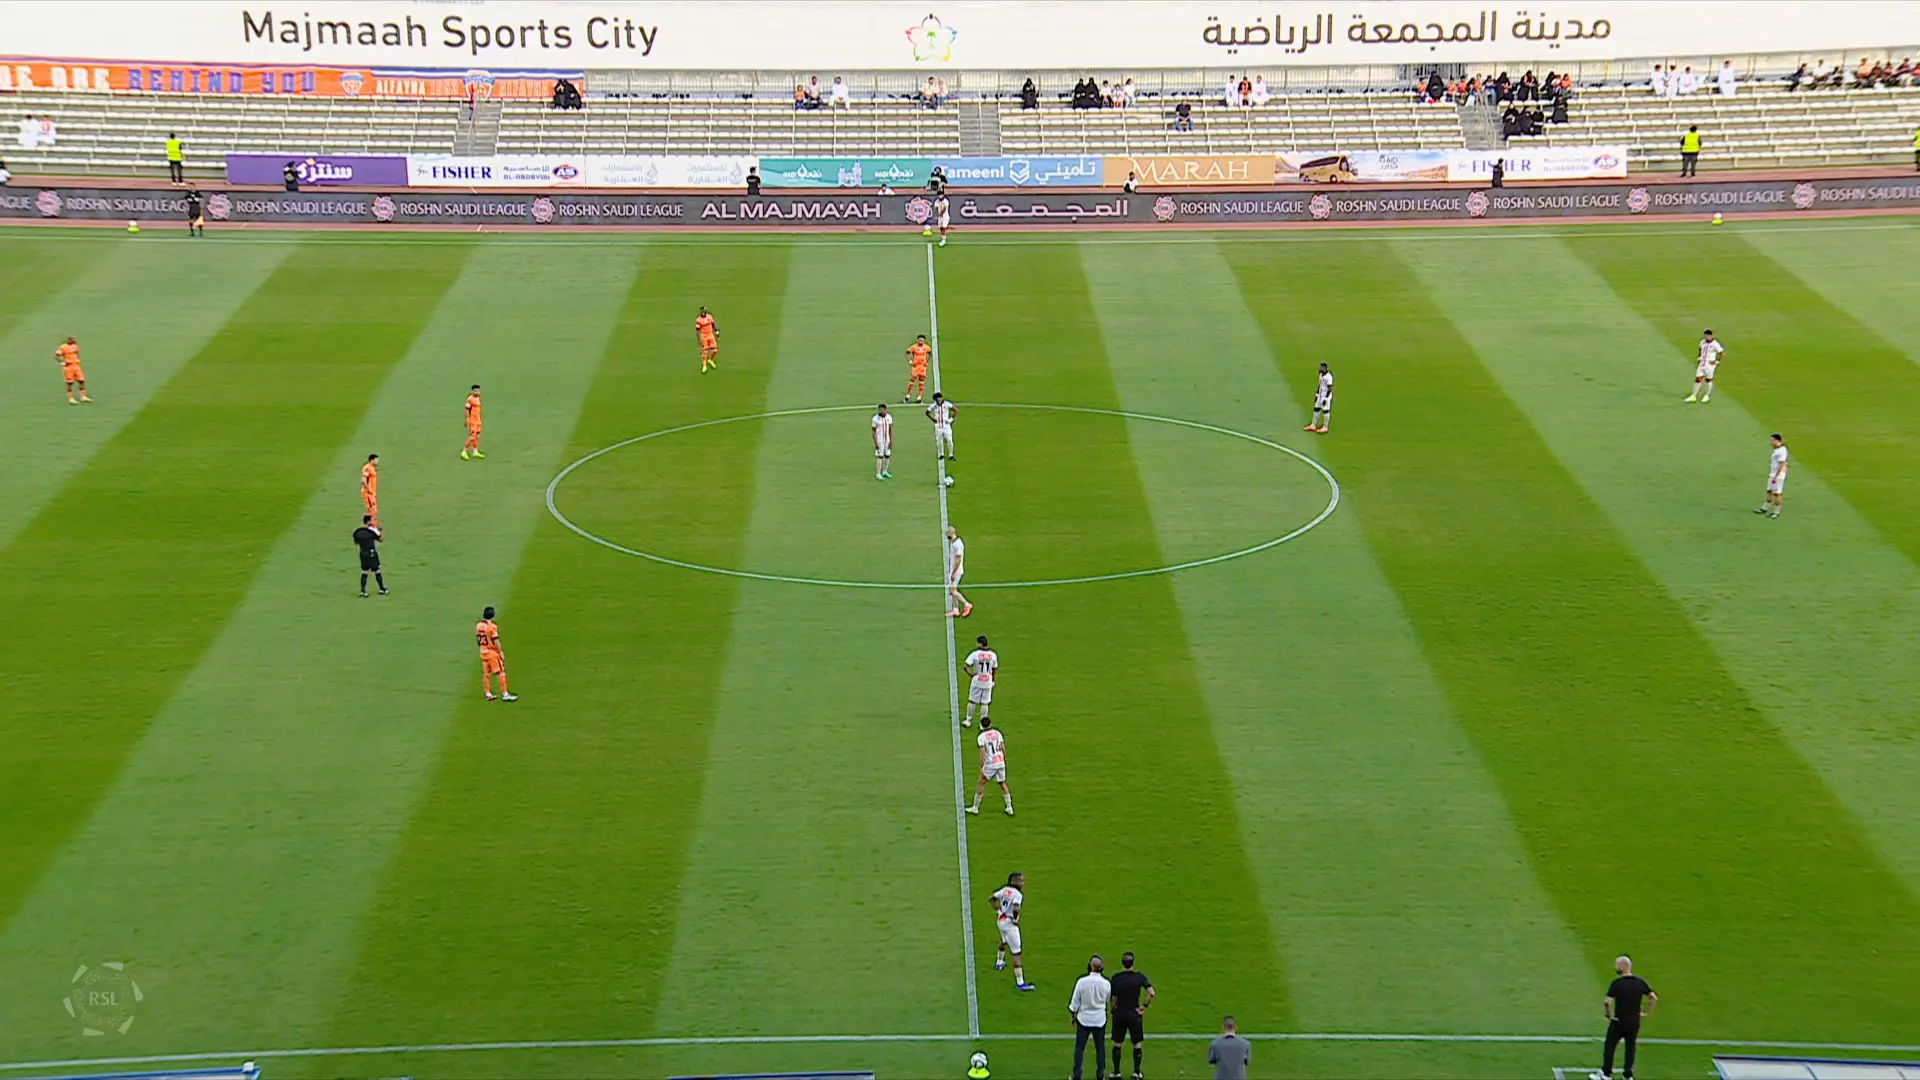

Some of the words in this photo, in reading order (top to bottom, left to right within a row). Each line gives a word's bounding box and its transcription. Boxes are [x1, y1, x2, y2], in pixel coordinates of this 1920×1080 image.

[242, 10, 428, 52] Majmaah
[442, 15, 573, 56] Sports
[586, 16, 658, 57] City
[1203, 13, 1334, 54] الرياضية
[1347, 10, 1498, 51] المجمعة
[1511, 10, 1612, 49] مدينة
[128, 68, 242, 93] BEHIND
[262, 71, 315, 93] YOU
[432, 165, 493, 180] FISHER
[1128, 157, 1249, 184] MARAH
[1655, 192, 1698, 206] ROSHN
[1701, 191, 1737, 205] SAUDI
[1739, 190, 1786, 204] LEAGUE
[1820, 188, 1866, 201] ROSHN
[1868, 186, 1907, 200] SAUDI
[66, 199, 112, 211] ROSHN
[114, 199, 153, 212] SAUDI
[156, 200, 189, 213] LEAG
[236, 200, 280, 214] ROSHN
[283, 201, 319, 215] SAUDI
[322, 201, 367, 215] LEAGUE
[400, 202, 442, 215] ROSHN
[445, 203, 480, 216] SAUDI
[483, 203, 527, 216] LEAGUE
[1180, 201, 1221, 214] ROSHN
[1224, 201, 1258, 214] SAUDI
[1261, 201, 1304, 214] LEAGUE
[1336, 200, 1377, 213] ROSHN
[1380, 199, 1415, 212] SAUDI
[1417, 198, 1461, 211] LEAGUE
[1493, 196, 1535, 209] ROSHN
[1538, 195, 1574, 209] SAUDI
[1576, 194, 1621, 208] LEAGUE
[559, 203, 600, 217] ROSHN
[603, 203, 638, 217] SAUDI
[640, 204, 684, 217] LEAGUE
[701, 202, 736, 219] AL
[740, 202, 881, 219] MAJMA'AH
[960, 199, 1129, 222] المجمعة
[476, 634, 489, 647] 23
[979, 661, 990, 674] 11
